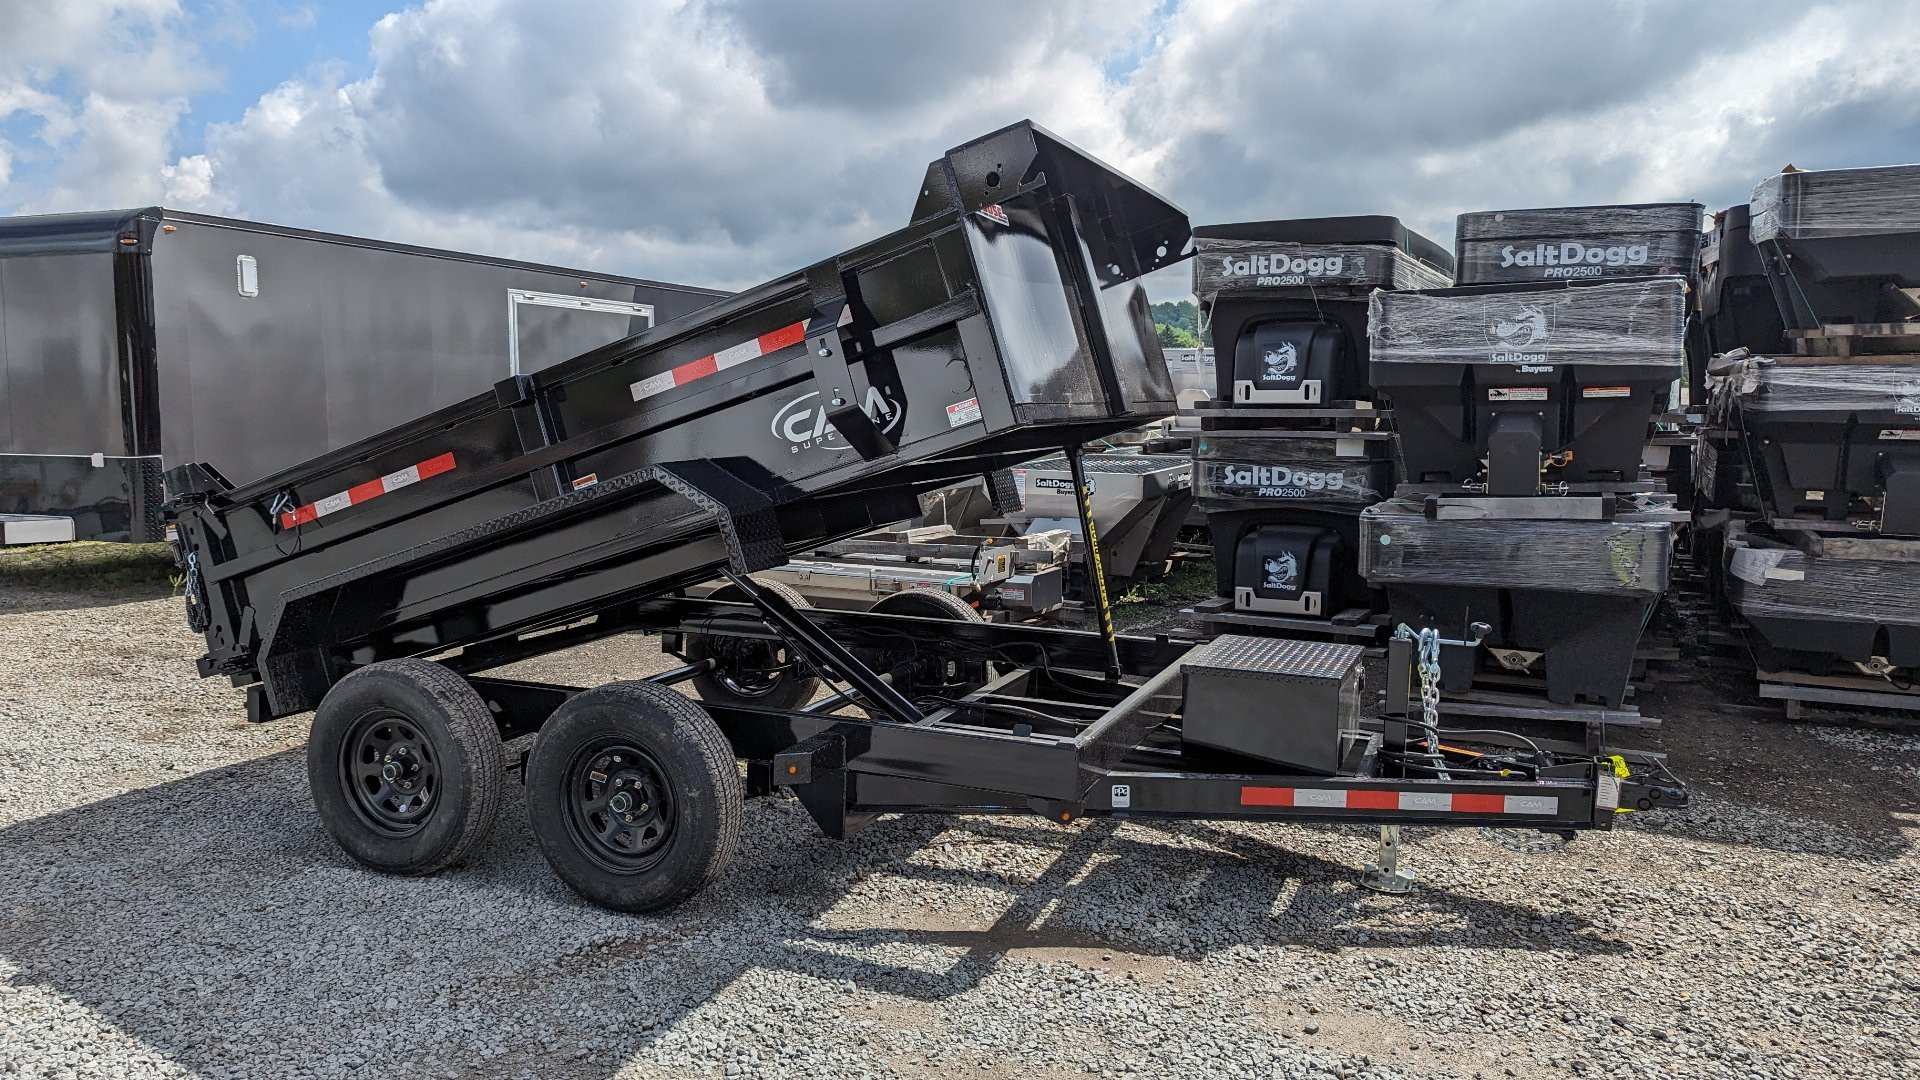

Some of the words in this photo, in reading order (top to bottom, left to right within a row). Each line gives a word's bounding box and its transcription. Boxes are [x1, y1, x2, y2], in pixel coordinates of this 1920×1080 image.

[1500, 242, 1648, 268] SaltDogg
[1222, 253, 1343, 277] SaltDogg
[1543, 266, 1602, 278] PRO2500
[1256, 275, 1305, 286] PRO2500
[1491, 352, 1546, 363] SaltDogg
[1521, 365, 1554, 374] Buyers
[791, 412, 893, 454] SUPENE
[392, 473, 408, 483] CAM
[1223, 464, 1344, 490] SaltDogg
[1258, 487, 1306, 497] PRO2500
[325, 498, 340, 508] CAM
[1262, 581, 1297, 591] SaltDogg
[1114, 787, 1127, 796] PPG
[1309, 793, 1331, 802] CAM
[1520, 800, 1542, 809] CAM
